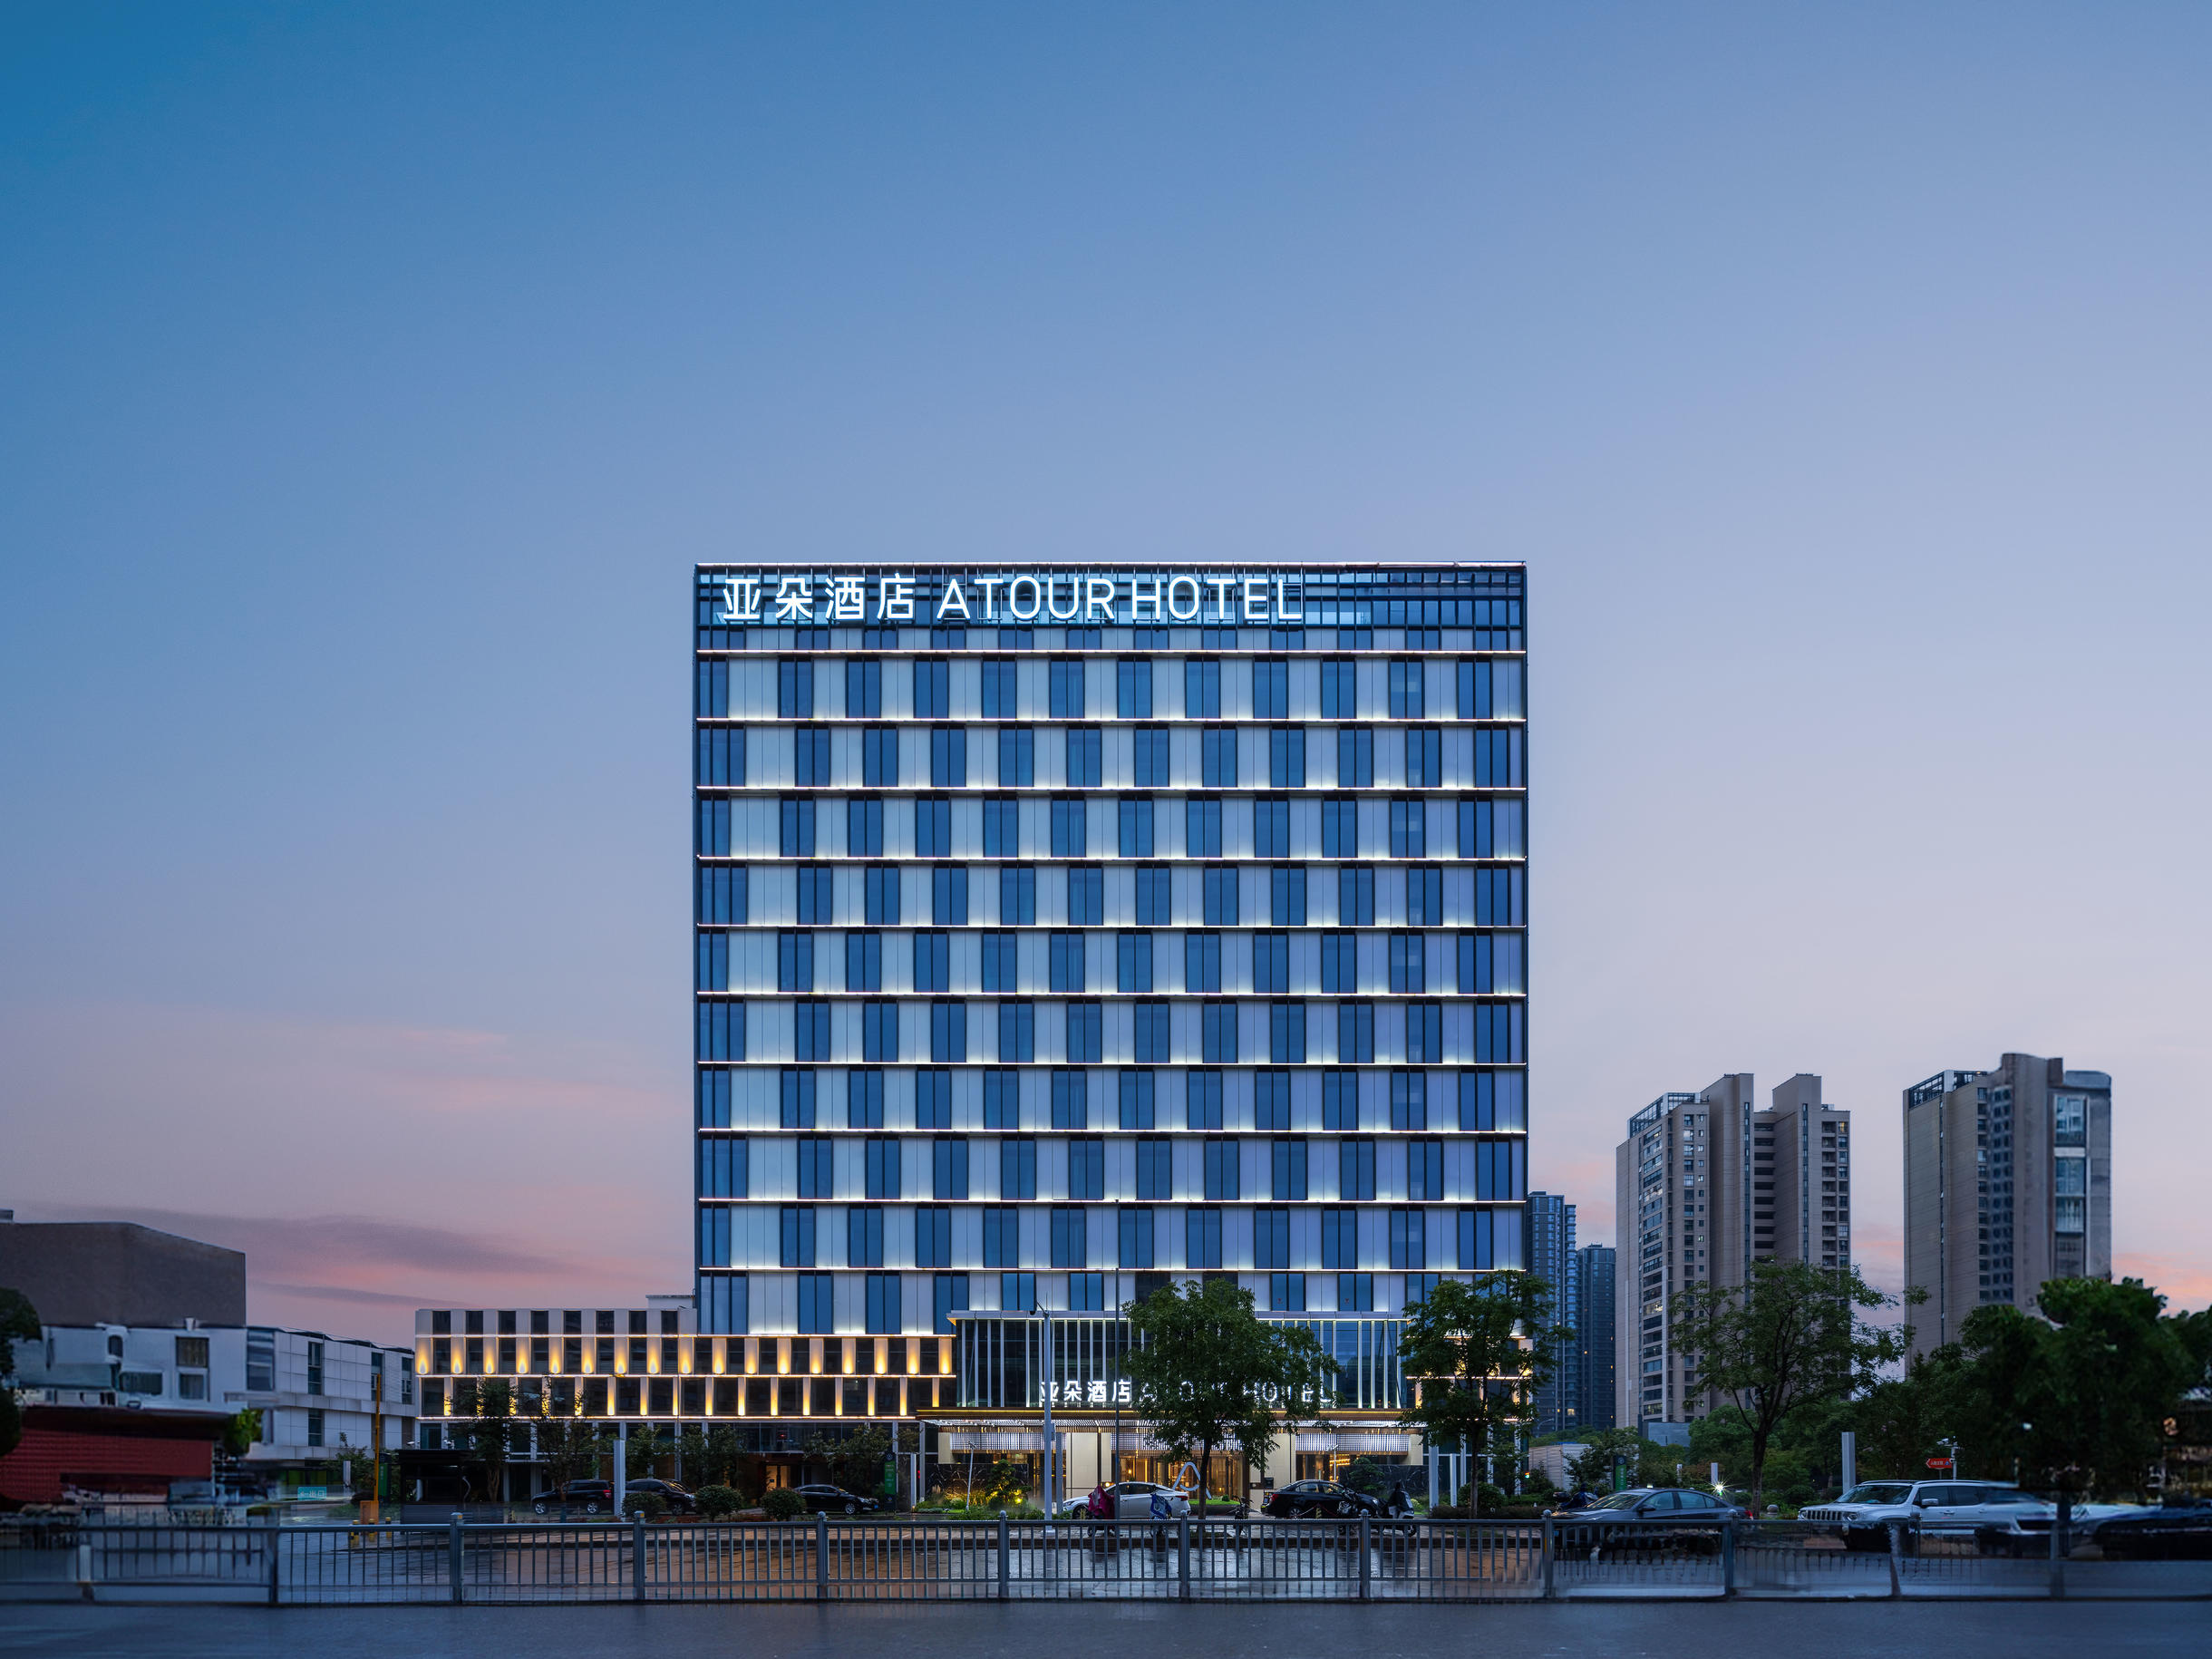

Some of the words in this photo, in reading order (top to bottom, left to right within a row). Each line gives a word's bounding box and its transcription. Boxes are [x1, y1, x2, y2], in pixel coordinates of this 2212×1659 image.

[723, 573, 916, 620] 亚朵酒店
[936, 575, 1116, 621] ATOUR
[1132, 576, 1303, 620] HOTEL
